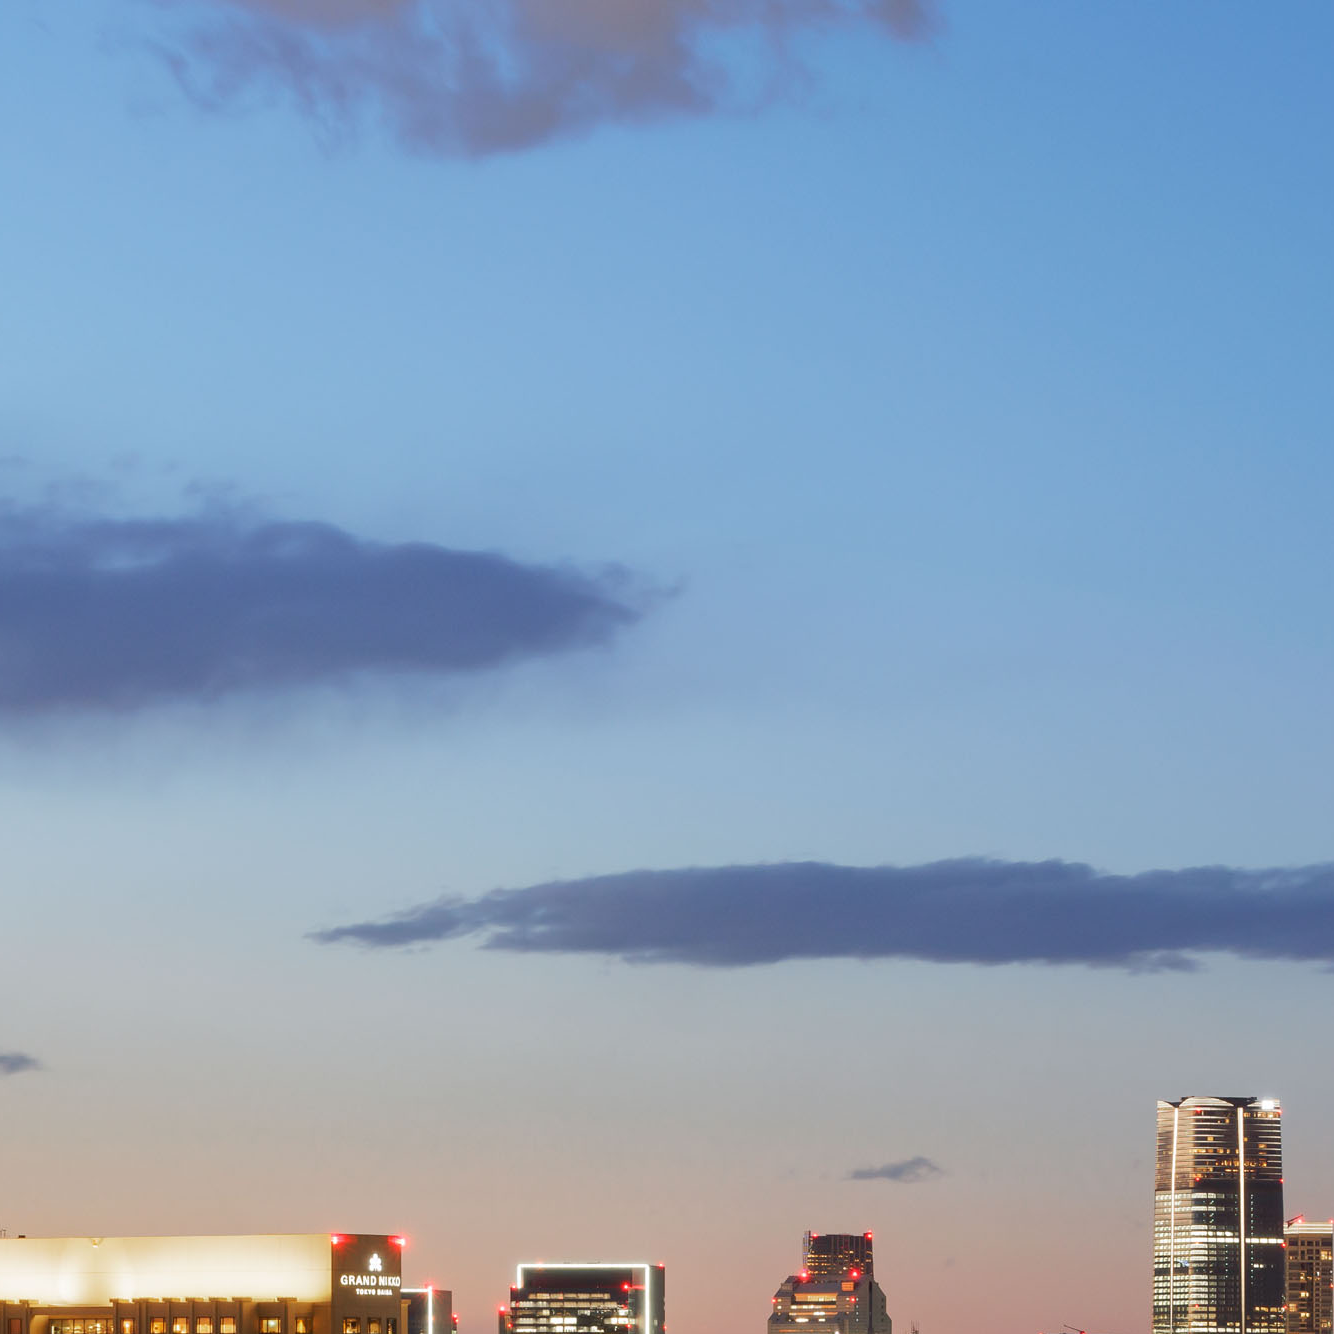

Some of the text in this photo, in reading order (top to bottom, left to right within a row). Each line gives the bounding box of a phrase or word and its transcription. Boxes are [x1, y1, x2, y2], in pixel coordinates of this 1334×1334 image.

[340, 1275, 401, 1287] GRAND NIKKO
[355, 1288, 376, 1296] TOKYO
